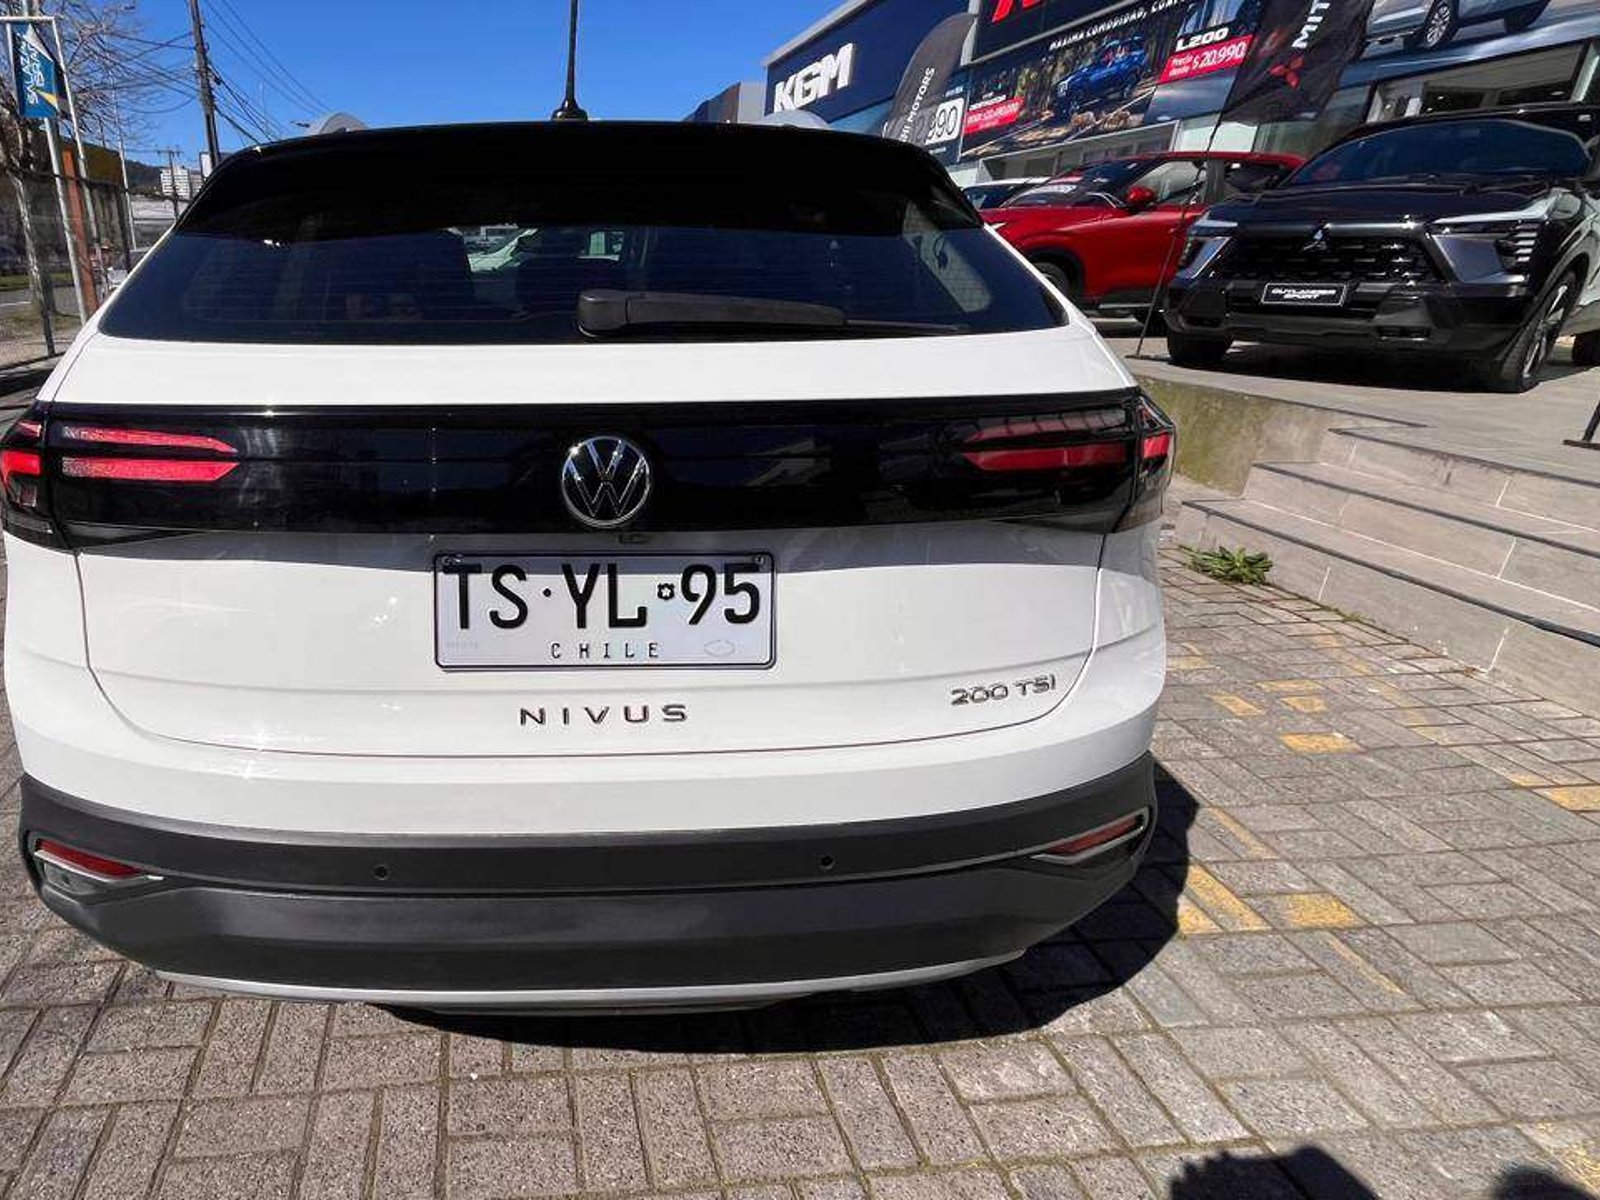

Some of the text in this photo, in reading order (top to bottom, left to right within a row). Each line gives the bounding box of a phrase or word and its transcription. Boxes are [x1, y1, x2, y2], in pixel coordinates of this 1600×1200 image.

[1175, 27, 1230, 52] L200
[774, 42, 854, 113] KGM
[907, 67, 935, 123] MOTORS
[550, 641, 660, 660] CHILE
[951, 674, 1057, 706] 200 TSI
[520, 703, 688, 726] NIVUS
